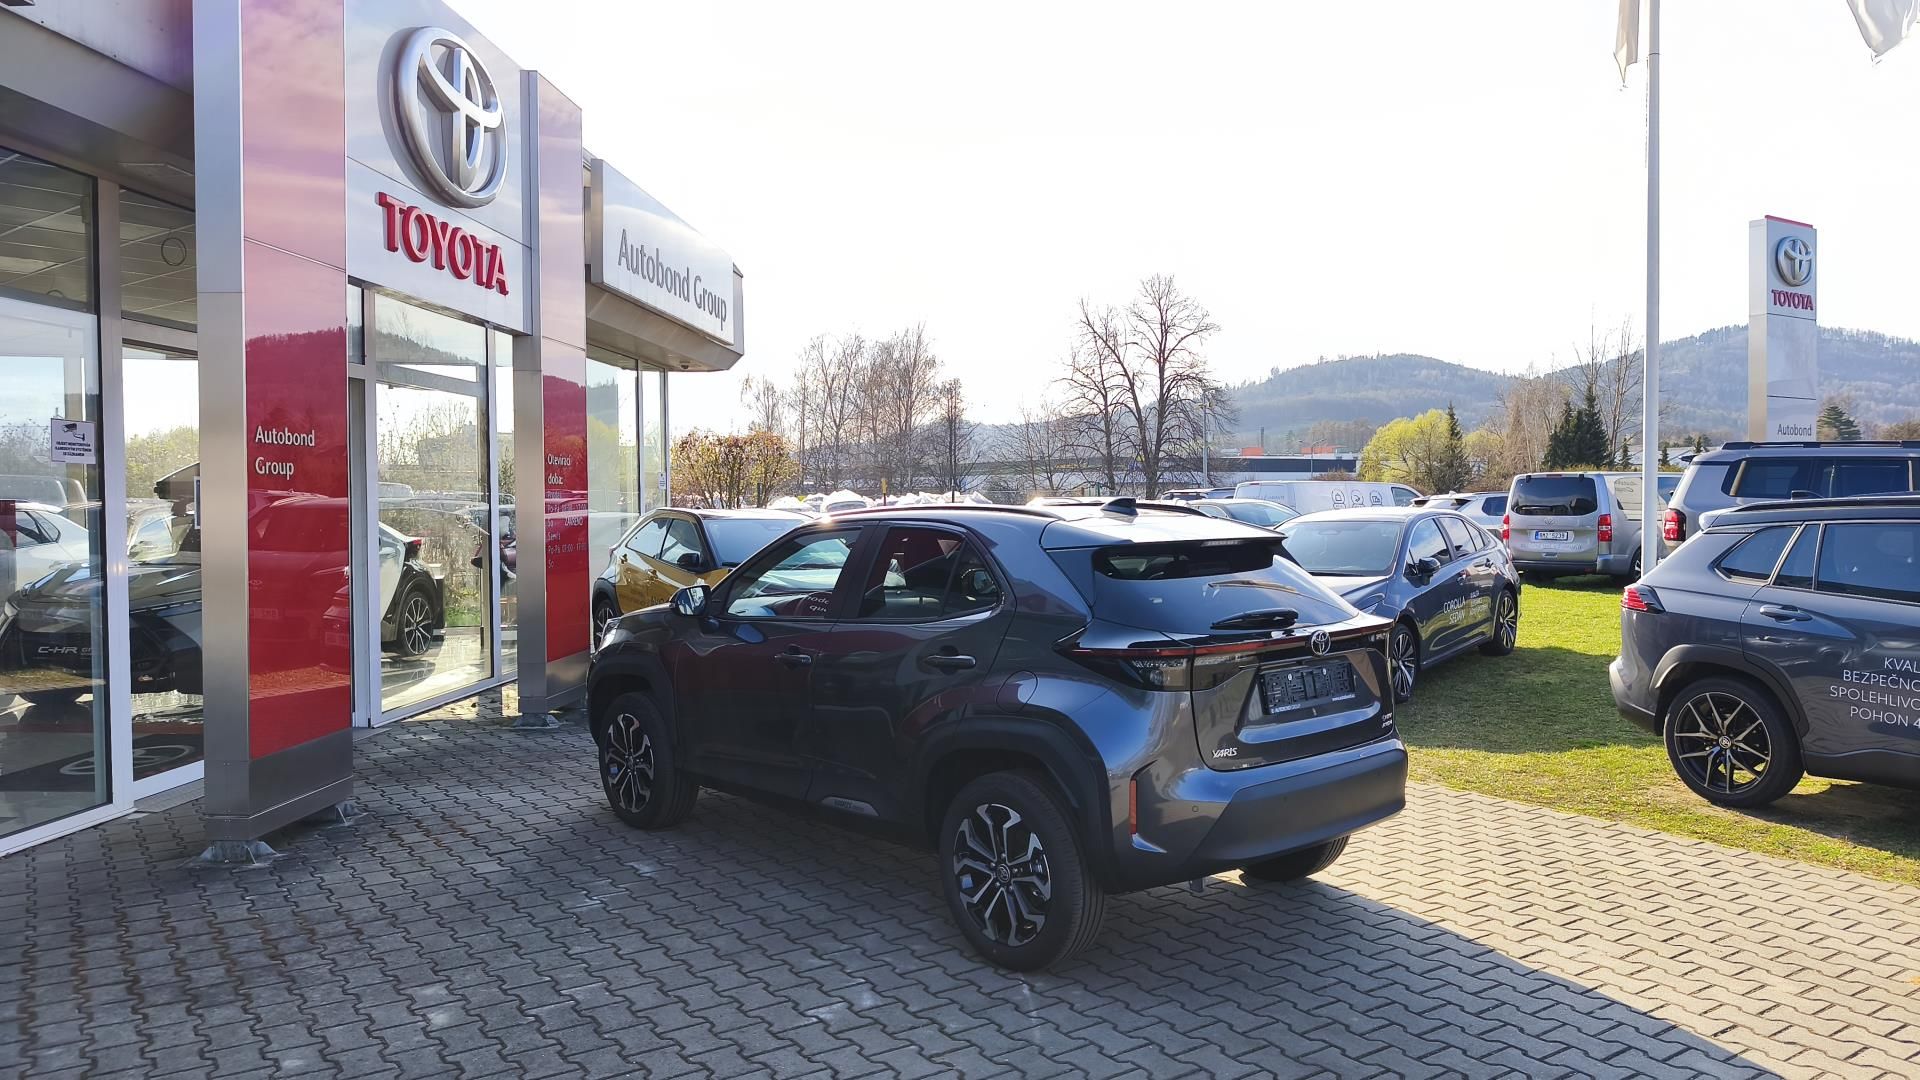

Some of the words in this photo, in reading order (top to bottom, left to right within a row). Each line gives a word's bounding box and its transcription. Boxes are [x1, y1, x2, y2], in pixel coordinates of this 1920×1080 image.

[375, 191, 509, 296] TOYOTA
[618, 228, 690, 303] Autobond
[694, 275, 727, 332] Group
[1771, 289, 1814, 311] TOYOTA
[255, 425, 315, 447] Autobond
[1777, 423, 1812, 436] Autobond
[255, 456, 295, 480] Group
[1443, 595, 1466, 614] COROLLA
[38, 646, 77, 654] C-HR
[1884, 656, 1920, 674] KVAL
[1843, 669, 1920, 692] BEZPEČNO
[1829, 685, 1920, 711] SPOLEHLIVO
[1850, 706, 1909, 727] POHON
[1212, 747, 1238, 759] YARIS
